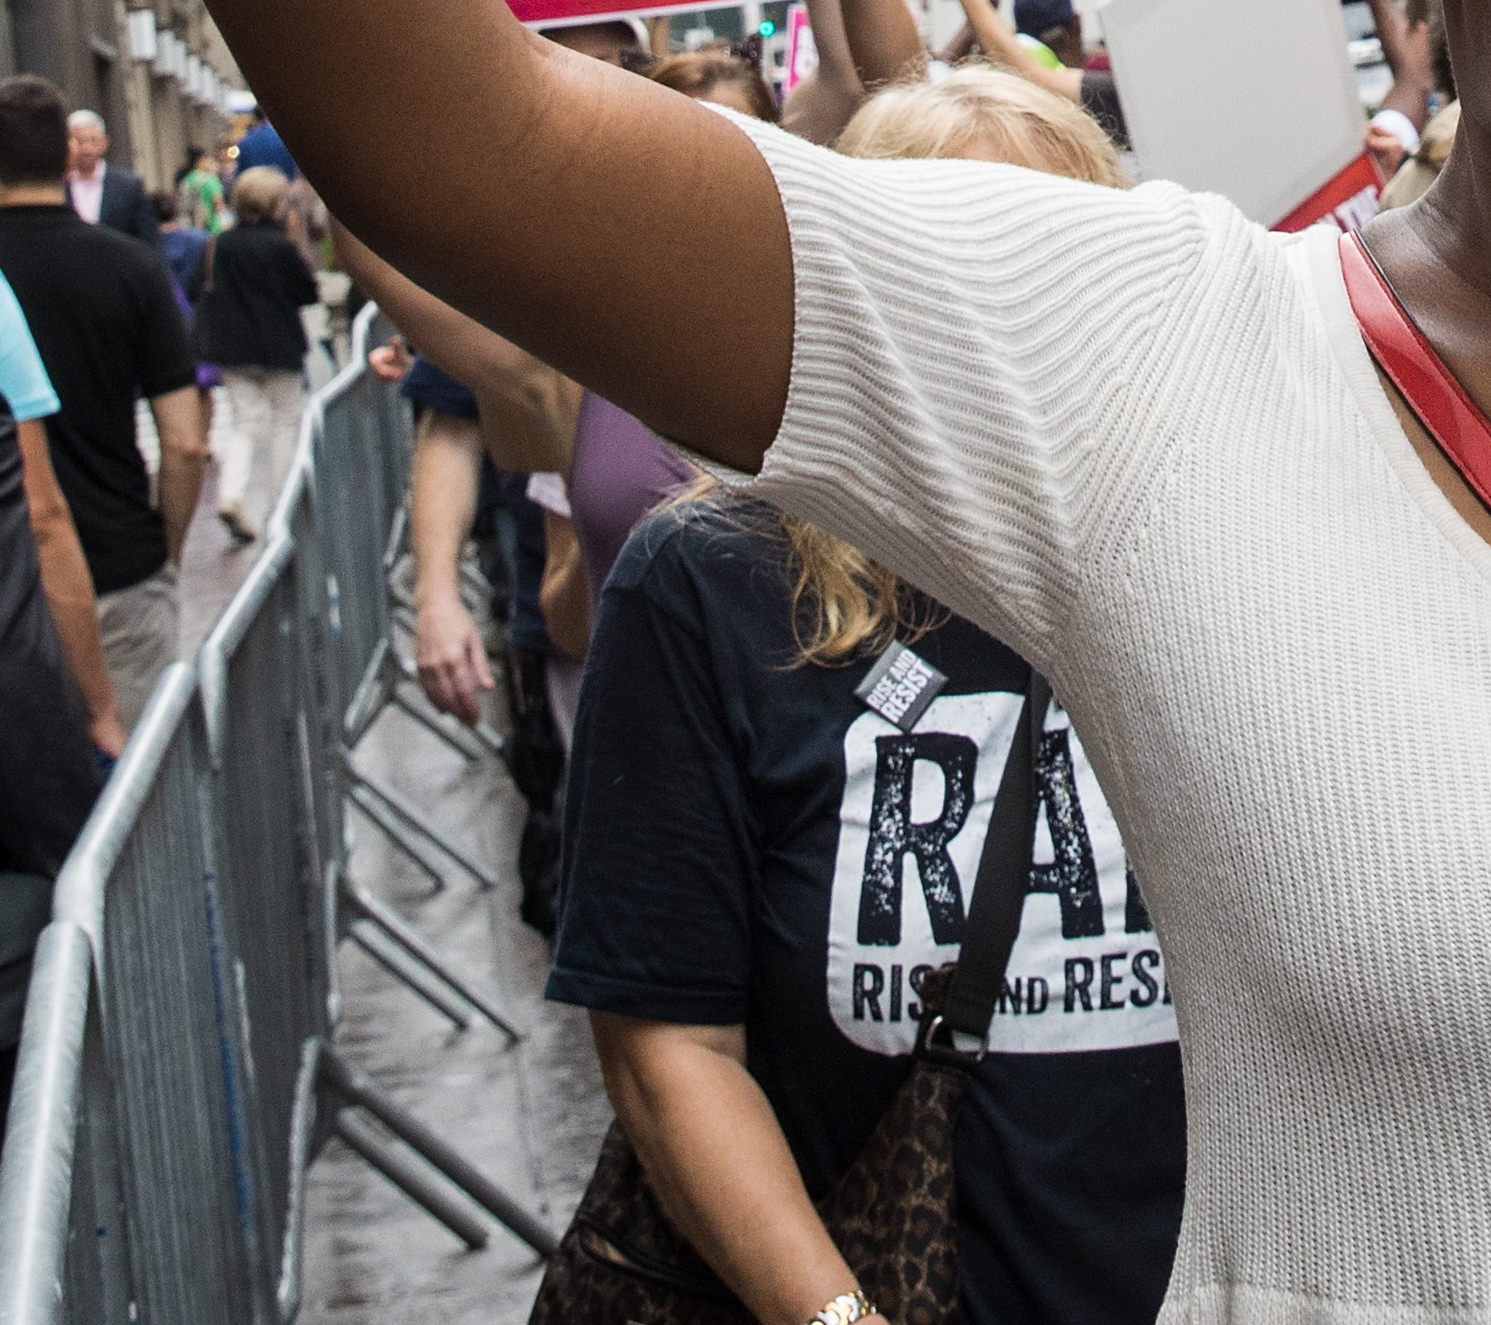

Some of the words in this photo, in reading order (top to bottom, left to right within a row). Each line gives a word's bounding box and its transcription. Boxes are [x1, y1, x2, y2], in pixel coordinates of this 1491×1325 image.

[866, 674, 898, 710] RISE
[889, 648, 918, 682] AND
[880, 658, 934, 724] RESIST
[857, 727, 1154, 946] RA
[853, 961, 949, 1023] RIS
[995, 976, 1050, 1015] ND
